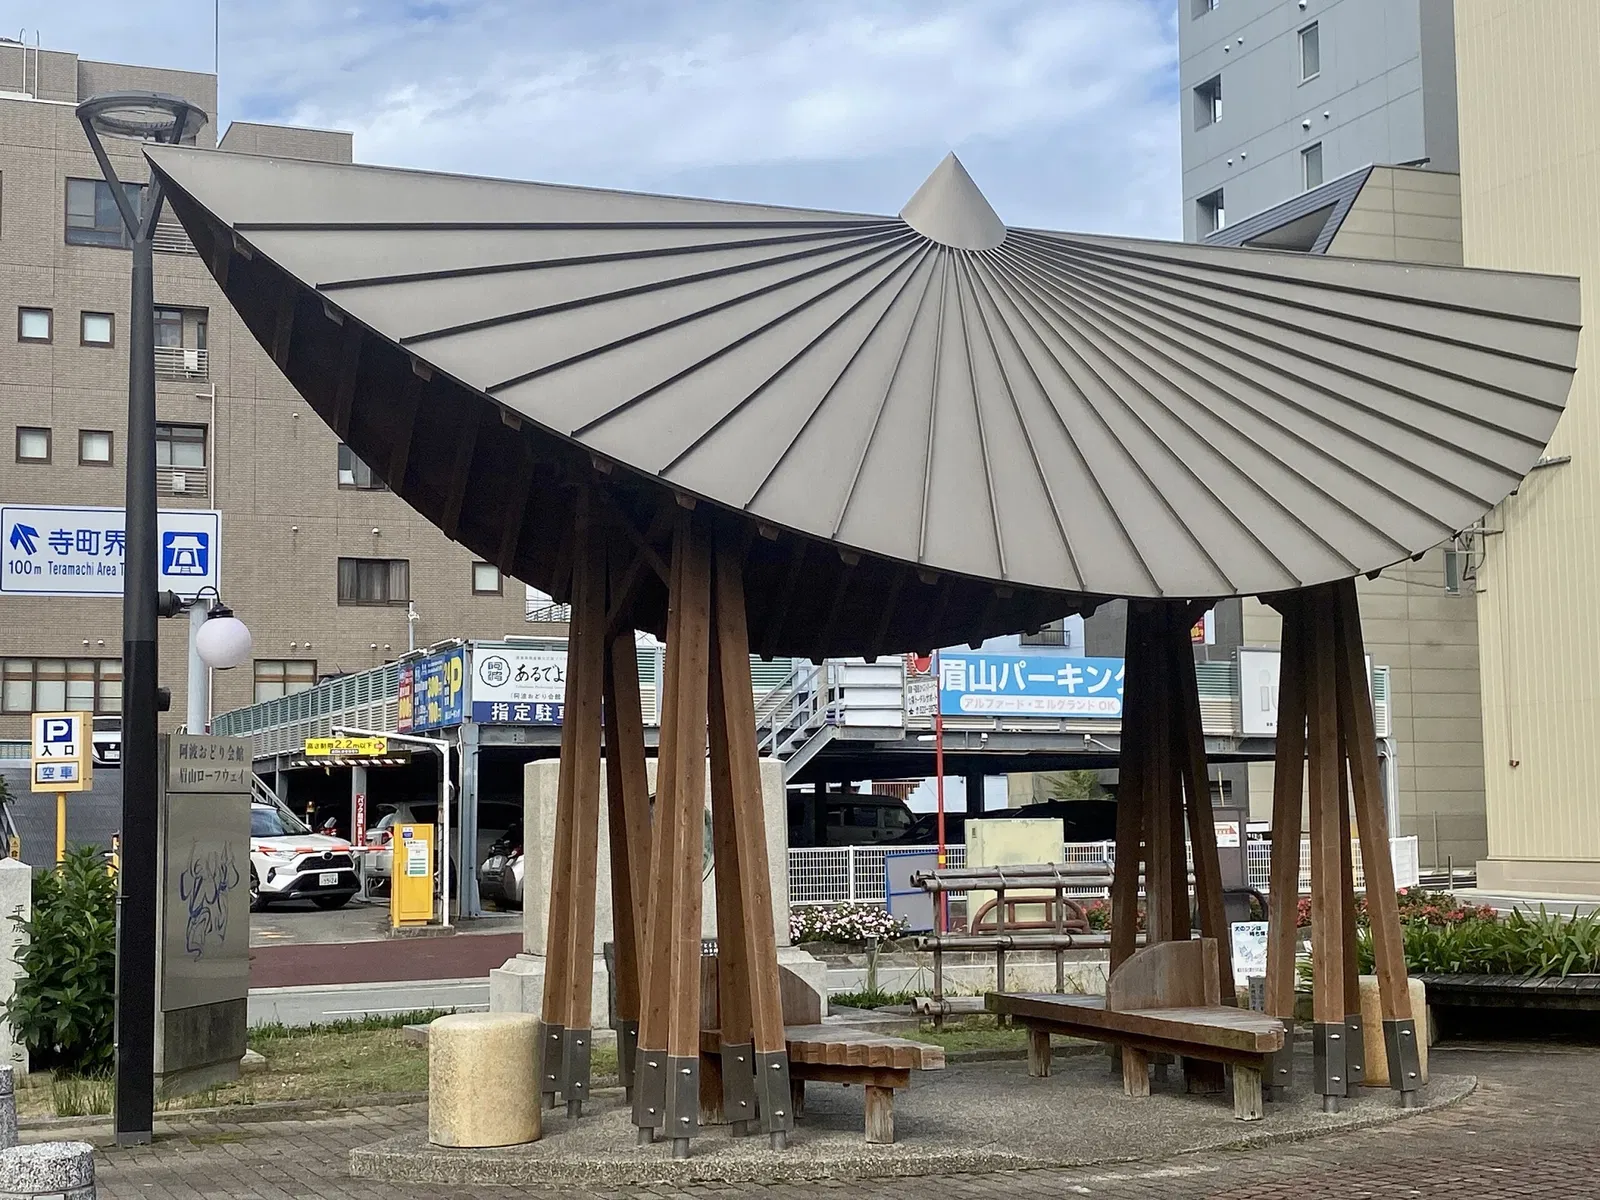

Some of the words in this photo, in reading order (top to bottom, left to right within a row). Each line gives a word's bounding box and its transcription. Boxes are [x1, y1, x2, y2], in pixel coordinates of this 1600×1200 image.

[48, 561, 94, 576] Teramachi
[97, 562, 117, 576] Area
[179, 743, 245, 761] 阿波おどり会館
[42, 766, 73, 779] 空車
